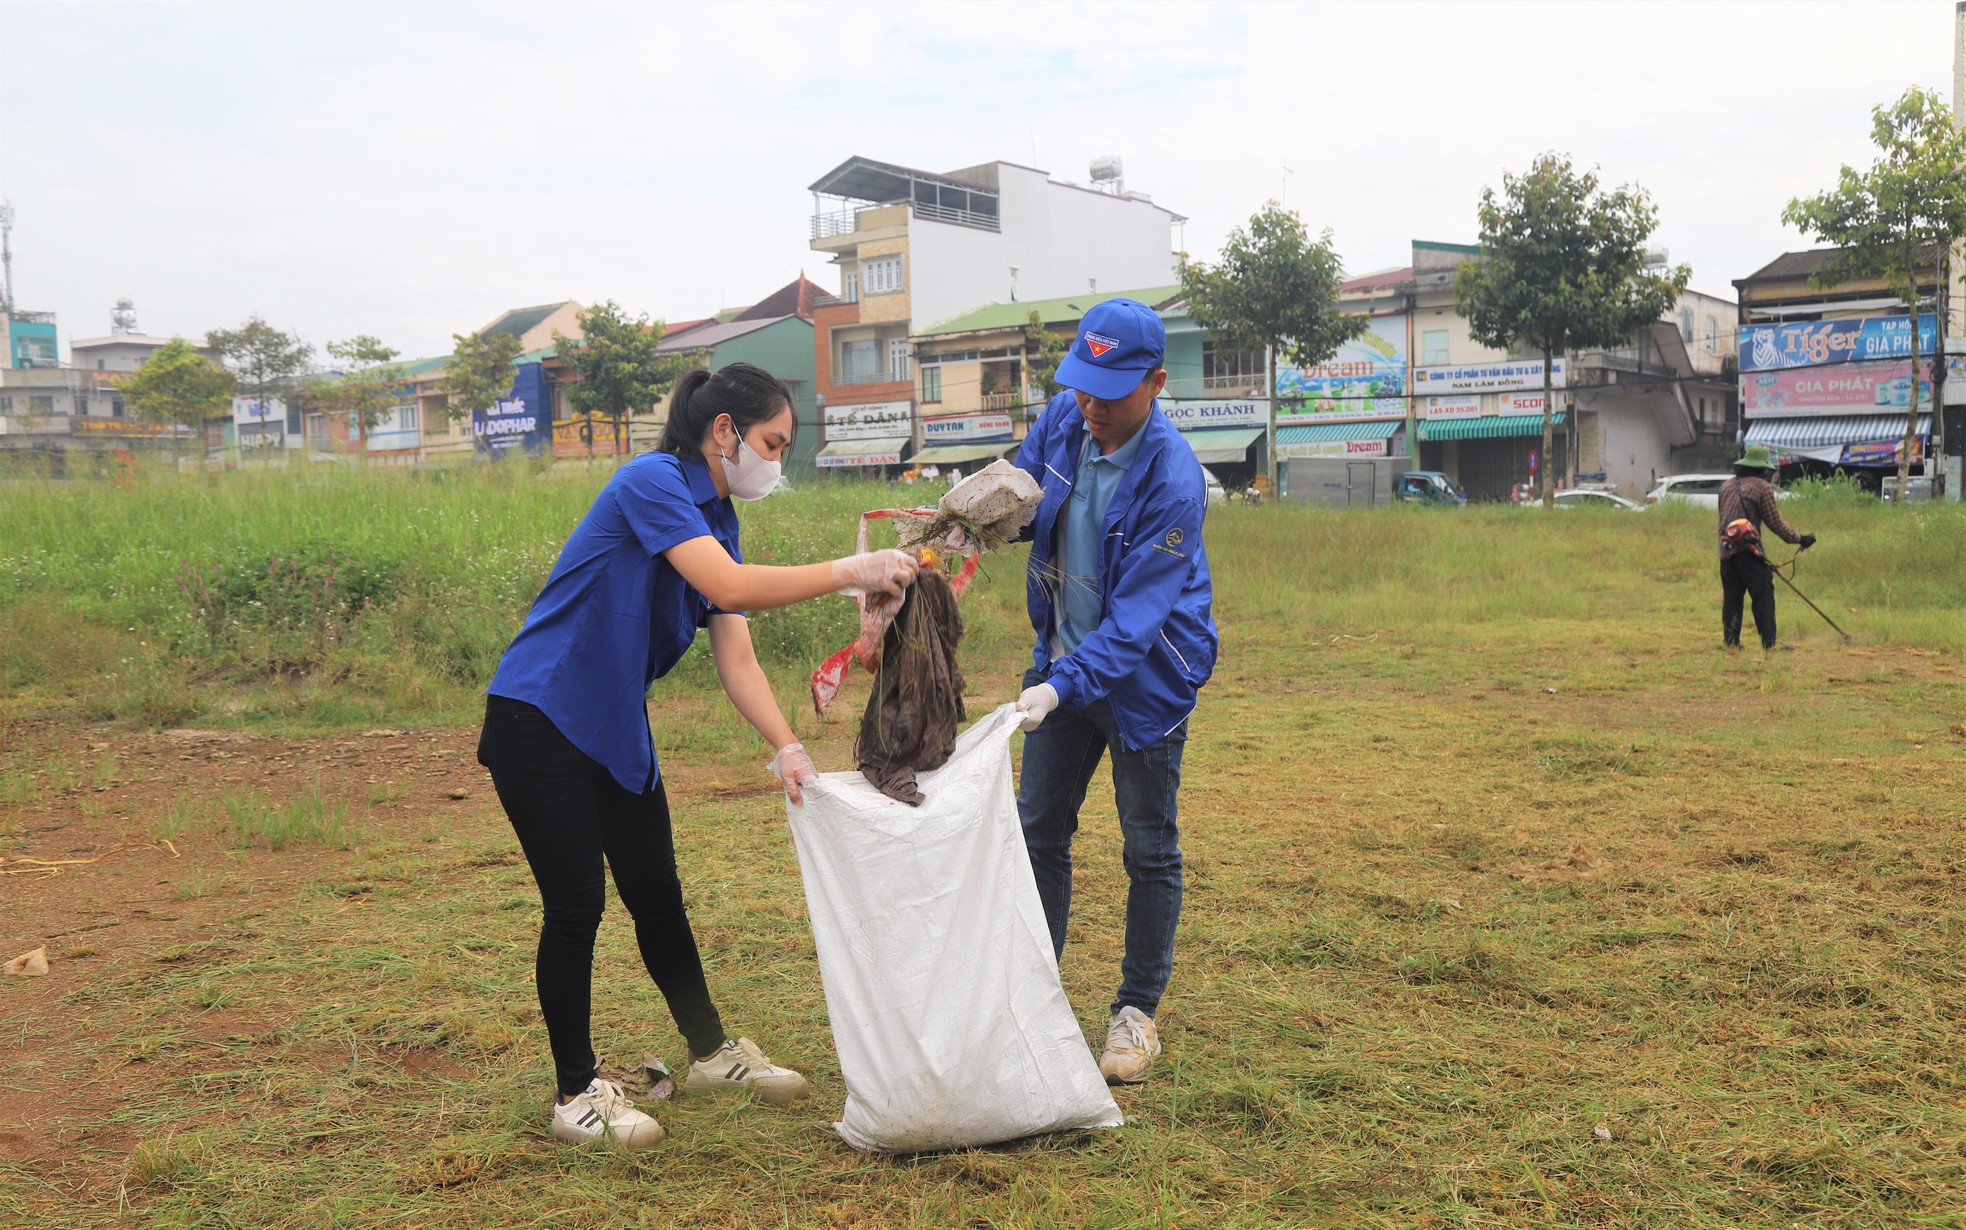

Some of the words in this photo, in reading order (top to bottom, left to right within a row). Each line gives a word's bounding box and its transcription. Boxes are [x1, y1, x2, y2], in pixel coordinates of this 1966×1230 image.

[1781, 324, 1864, 363] Tiger
[1866, 336, 1889, 353] GIA
[1303, 361, 1374, 379] Dream
[1453, 381, 1472, 389] NAM
[1474, 379, 1494, 388] LÂM
[1795, 380, 1824, 393] GIA
[1828, 375, 1873, 392] PHÁT
[863, 411, 898, 424] DÂN
[1163, 408, 1195, 420] GỌC
[1200, 403, 1255, 417] KHÁNH
[1346, 441, 1382, 453] Dream
[849, 454, 866, 465] TẾ
[870, 454, 897, 464] DÂN
